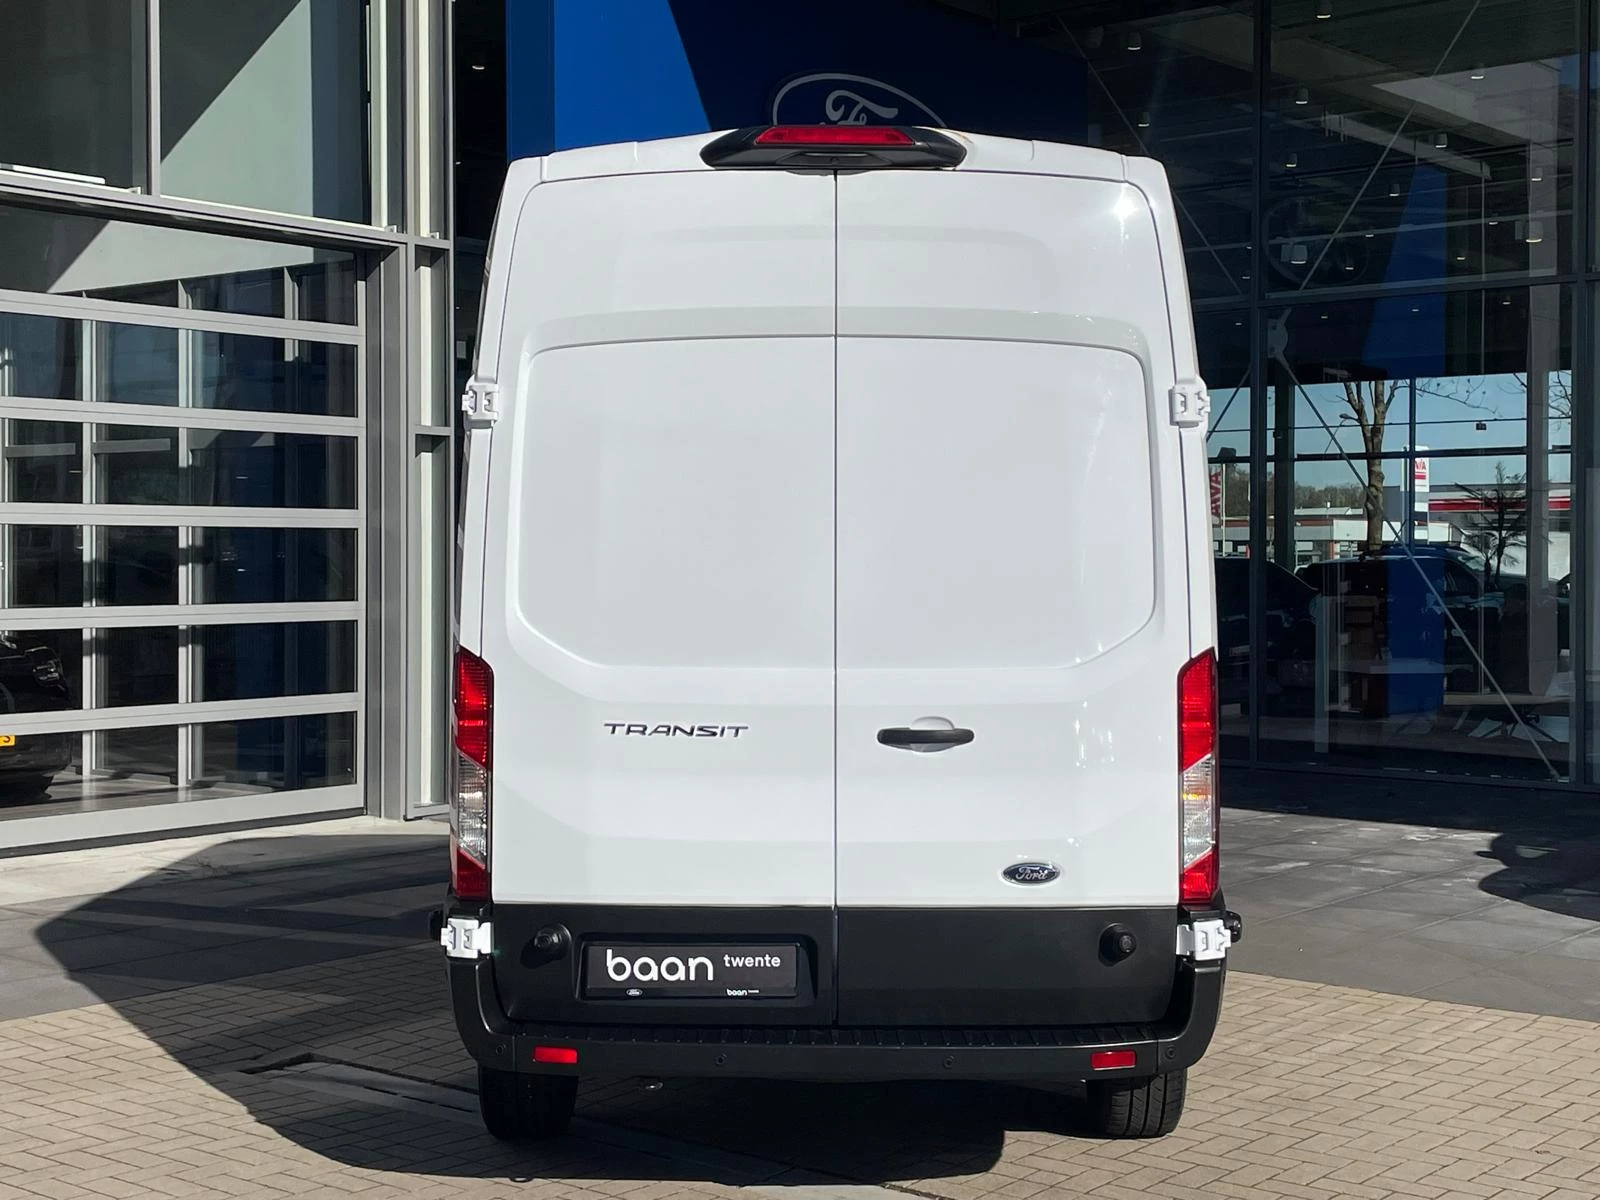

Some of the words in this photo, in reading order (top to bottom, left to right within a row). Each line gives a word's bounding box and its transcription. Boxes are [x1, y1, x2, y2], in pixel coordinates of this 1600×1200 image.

[603, 723, 749, 738] TRANSIT
[606, 948, 714, 982] baan
[723, 953, 781, 968] twente
[726, 988, 748, 996] baan
